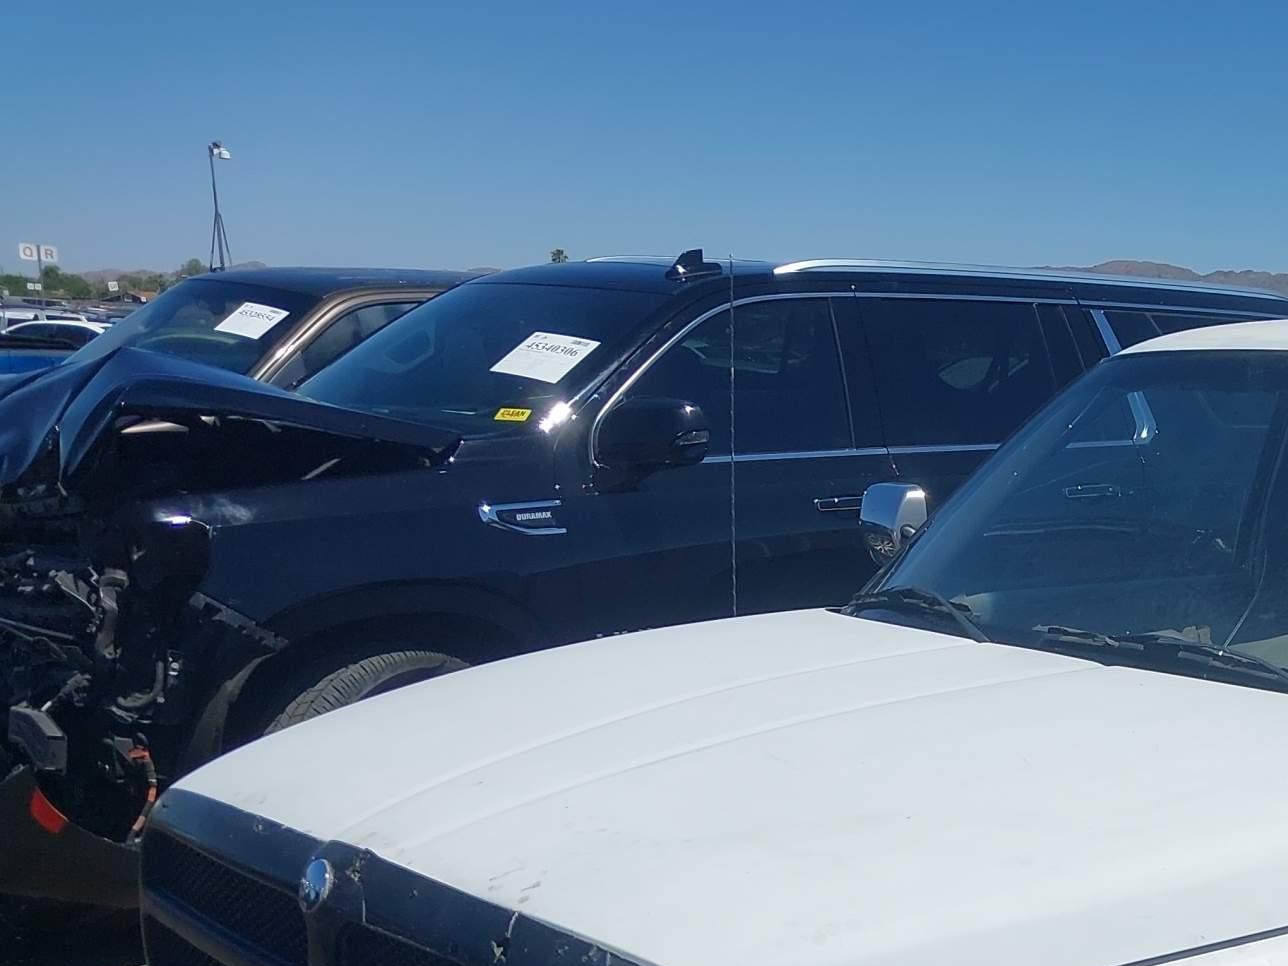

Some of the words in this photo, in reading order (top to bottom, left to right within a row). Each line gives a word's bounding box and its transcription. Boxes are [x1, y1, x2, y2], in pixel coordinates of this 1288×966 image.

[22, 245, 34, 258] Q
[44, 248, 55, 260] R
[516, 511, 552, 521] DURAMAX
